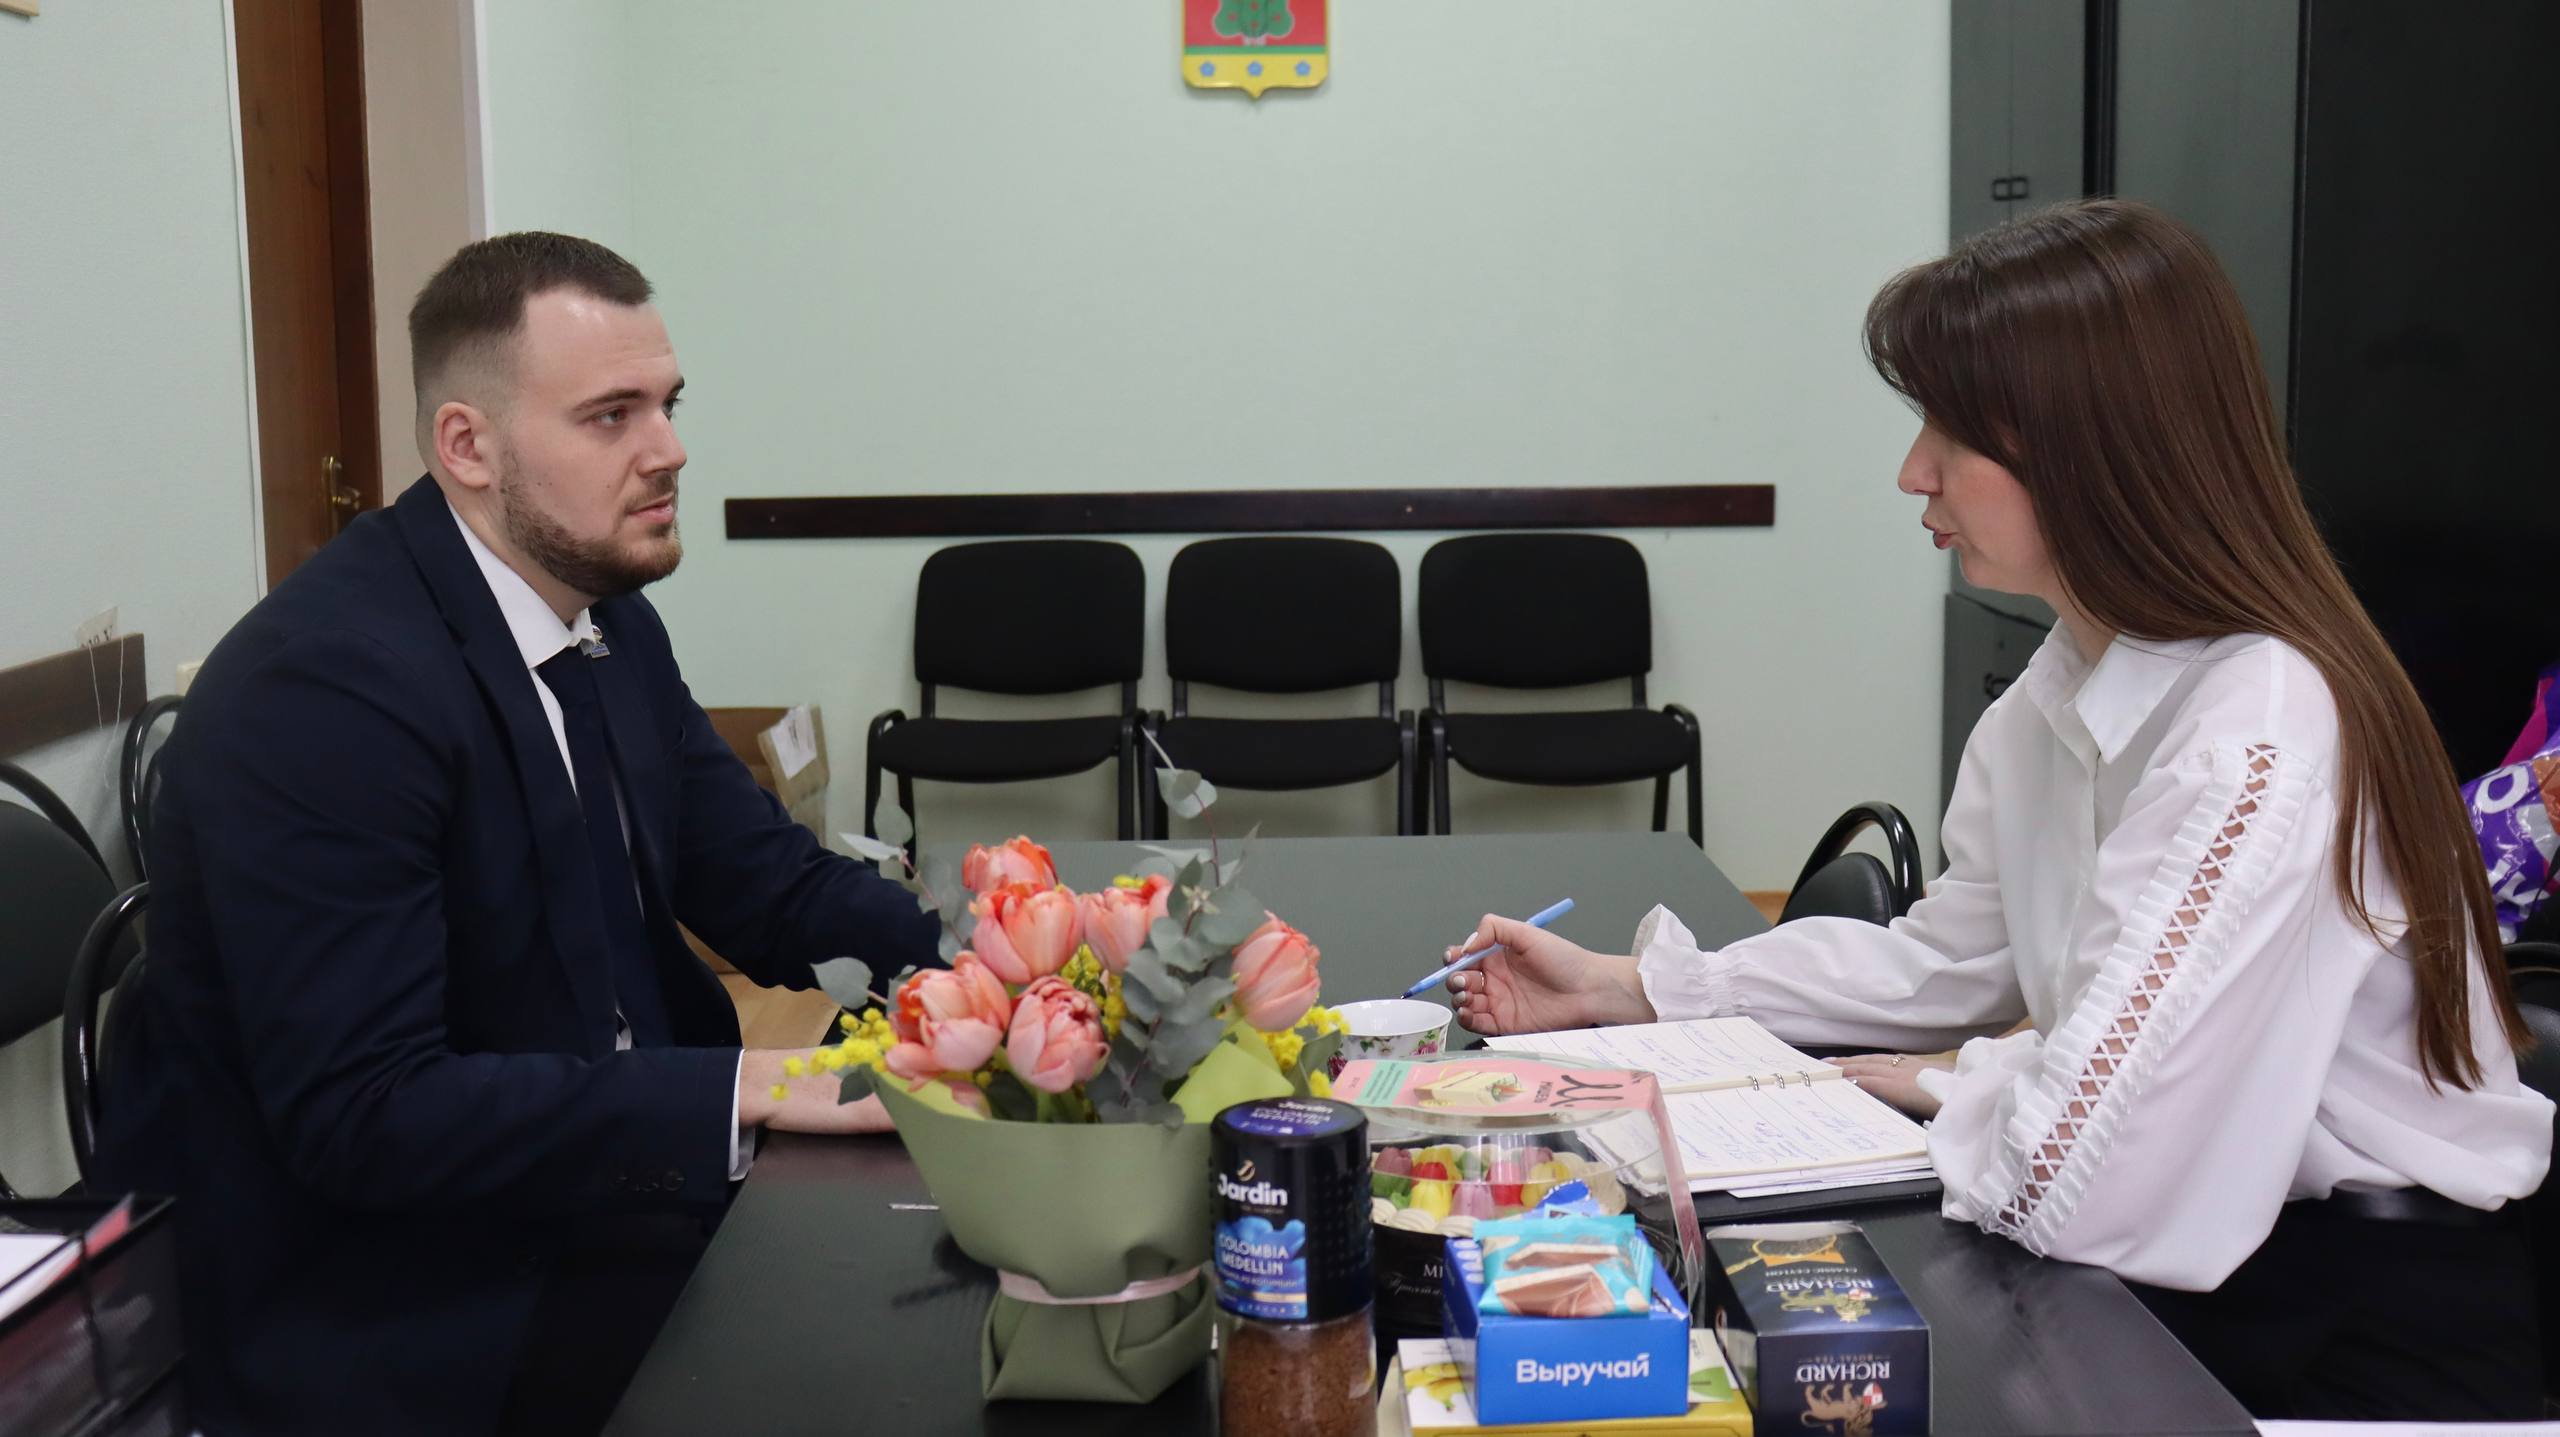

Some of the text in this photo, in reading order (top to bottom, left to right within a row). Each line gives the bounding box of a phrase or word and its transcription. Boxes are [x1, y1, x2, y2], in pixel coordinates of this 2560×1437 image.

[1217, 1173, 1288, 1206] Jardin
[1218, 1234, 1289, 1259] COLOMBIA
[1221, 1251, 1284, 1276] MEDELLIN
[1423, 1263, 1443, 1279] MI
[1766, 1278, 1874, 1293] RICHARD
[1516, 1353, 1650, 1387] Выручай
[1795, 1361, 1890, 1382] RICHARD
